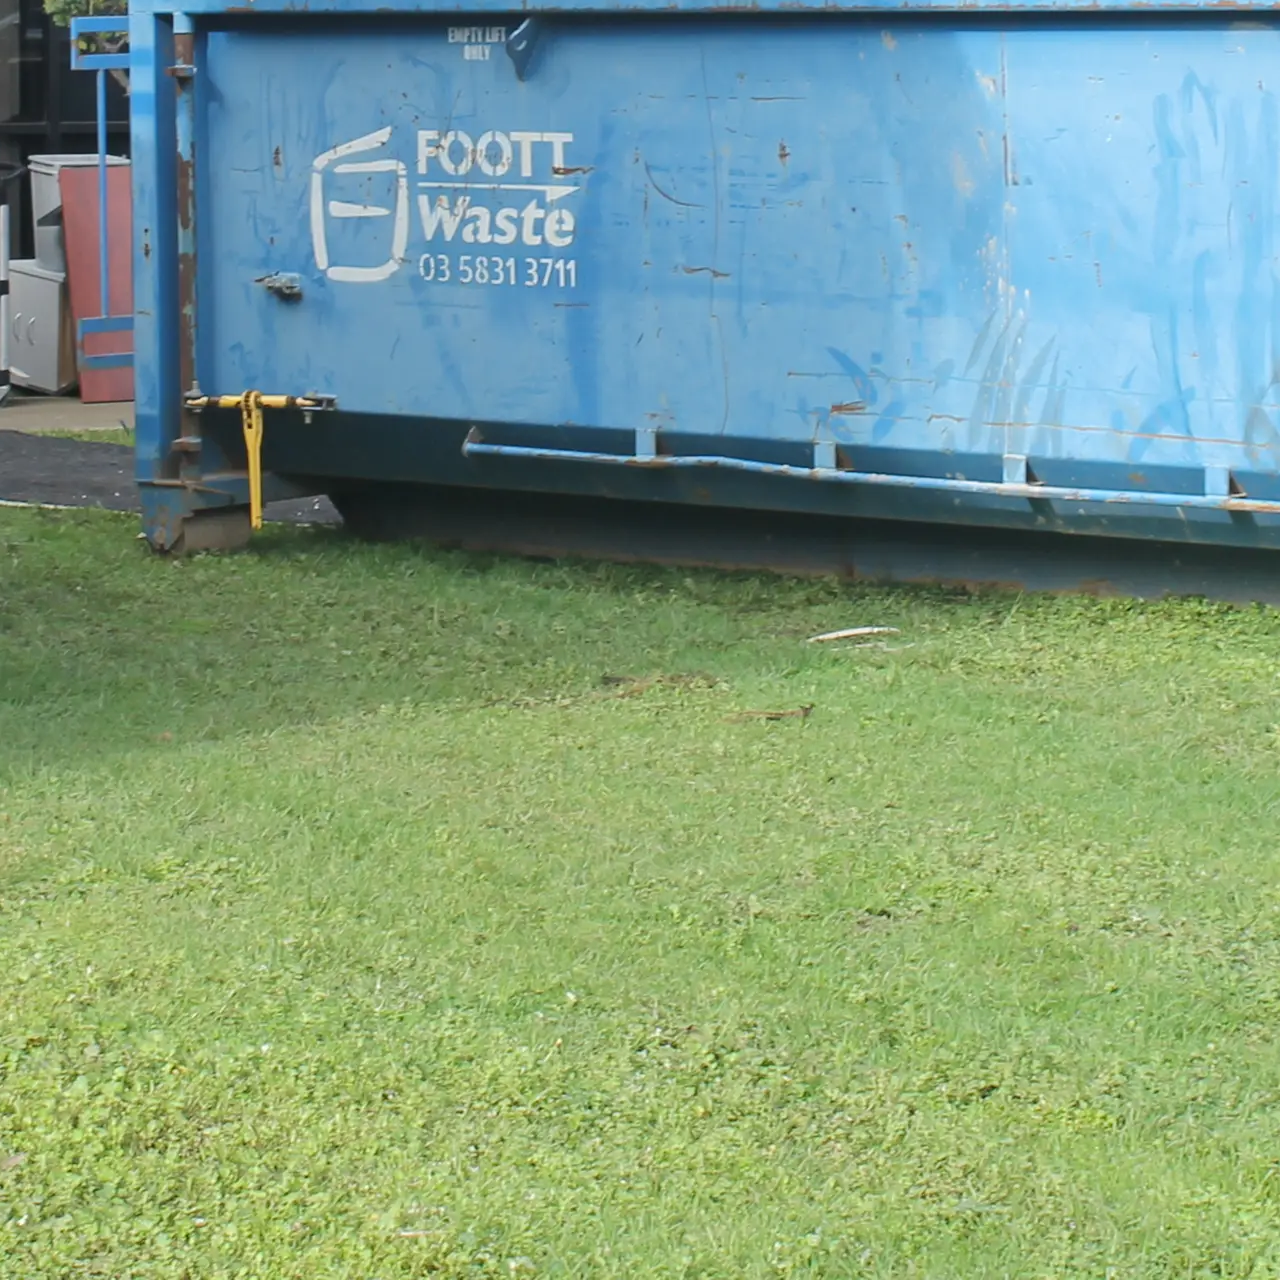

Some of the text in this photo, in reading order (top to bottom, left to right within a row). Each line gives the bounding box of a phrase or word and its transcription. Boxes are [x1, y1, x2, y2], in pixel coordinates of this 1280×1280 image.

[448, 26, 506, 43] EMPTY LIFT
[463, 44, 491, 60] ONLY
[417, 130, 573, 178] FOOTT
[417, 194, 575, 247] Waste
[419, 253, 577, 288] 03 5831 3711
